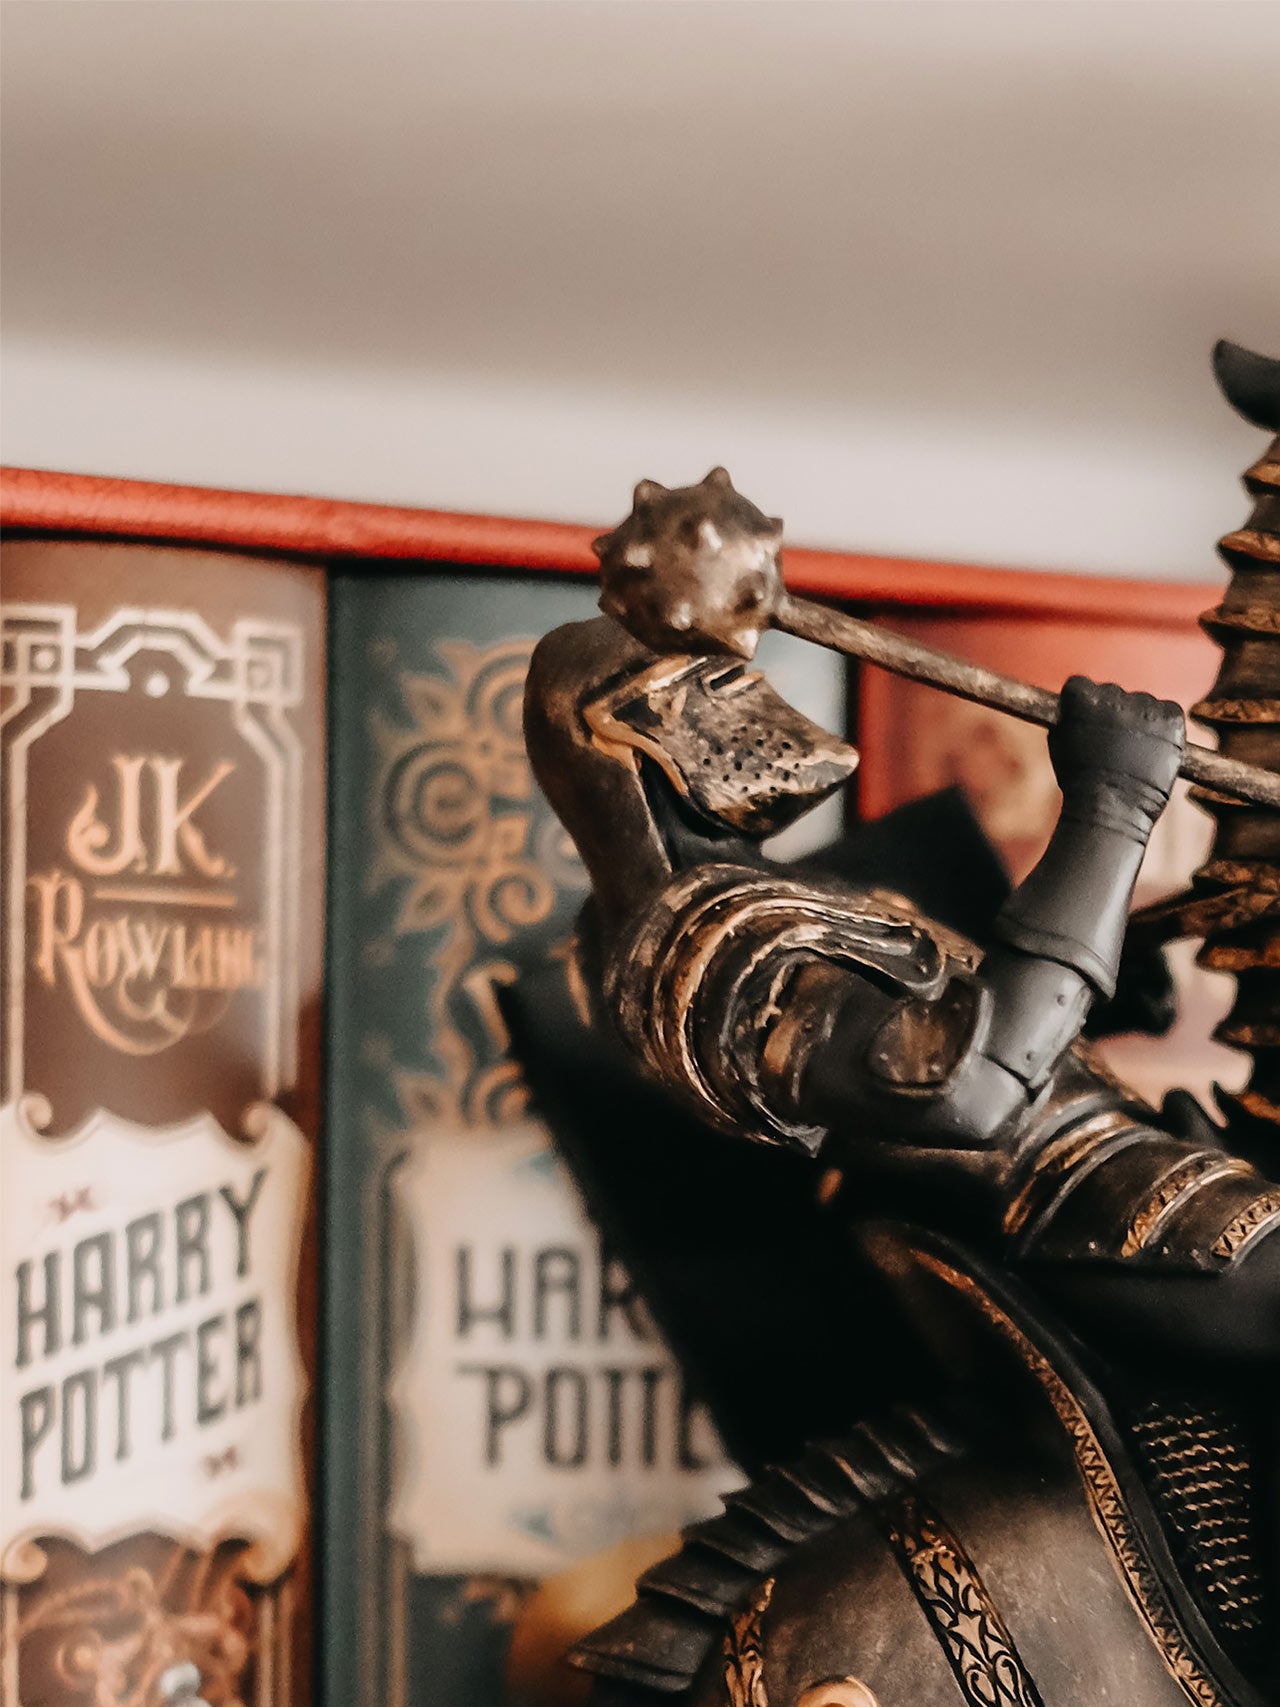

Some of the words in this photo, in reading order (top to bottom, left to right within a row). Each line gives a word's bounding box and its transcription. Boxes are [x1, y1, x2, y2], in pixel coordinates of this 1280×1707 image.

[14, 1165, 268, 1371] HARRY
[454, 1242, 658, 1342] HAR
[18, 1297, 264, 1503] POTTER
